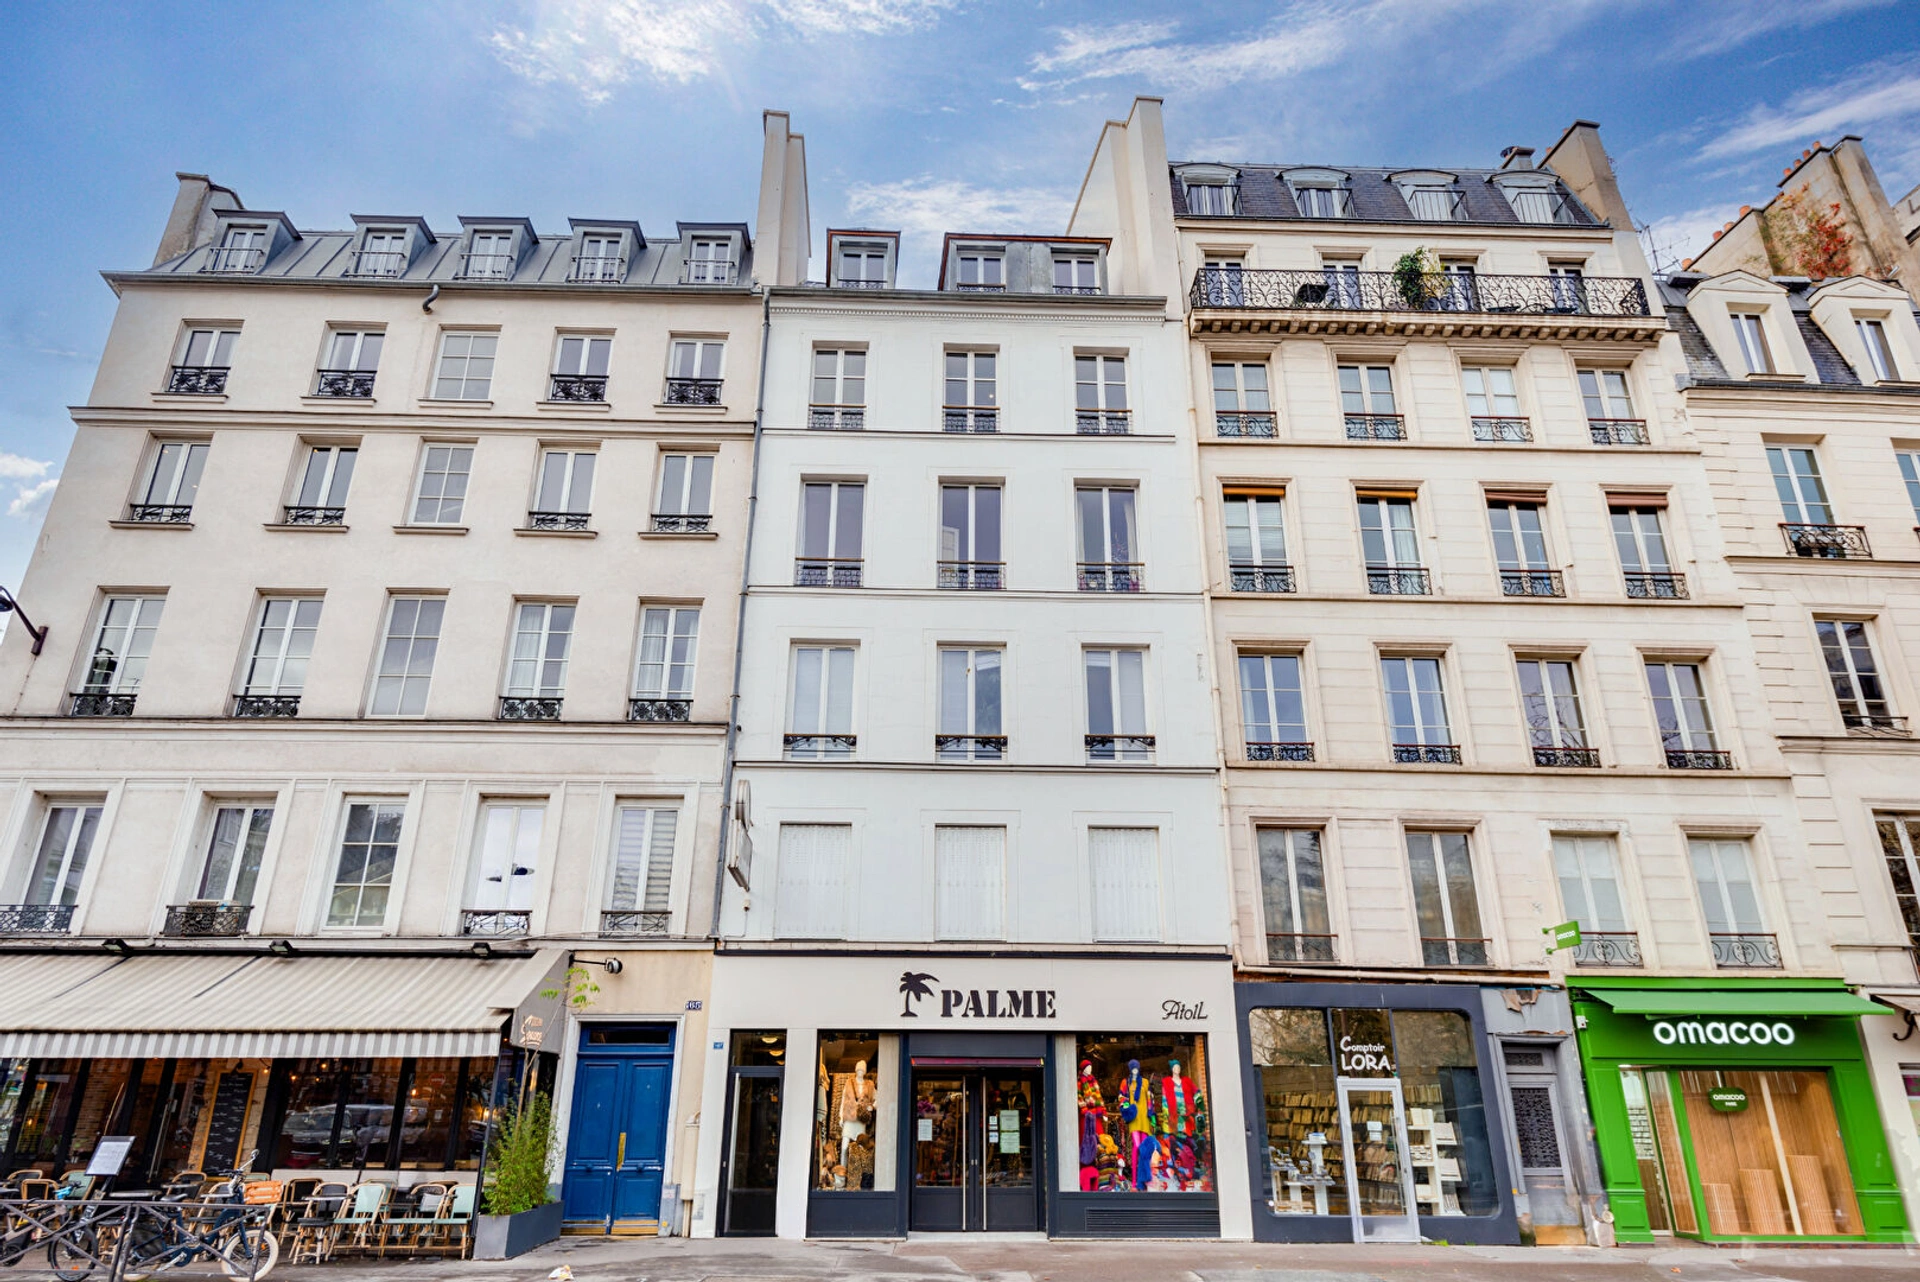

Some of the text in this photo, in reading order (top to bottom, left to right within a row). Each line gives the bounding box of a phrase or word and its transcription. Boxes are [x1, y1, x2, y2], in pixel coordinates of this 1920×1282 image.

[940, 989, 1056, 1018] PALME
[1653, 1021, 1796, 1045] omacoo
[1340, 1035, 1386, 1054] Comptoir
[1341, 1053, 1391, 1071] LORA
